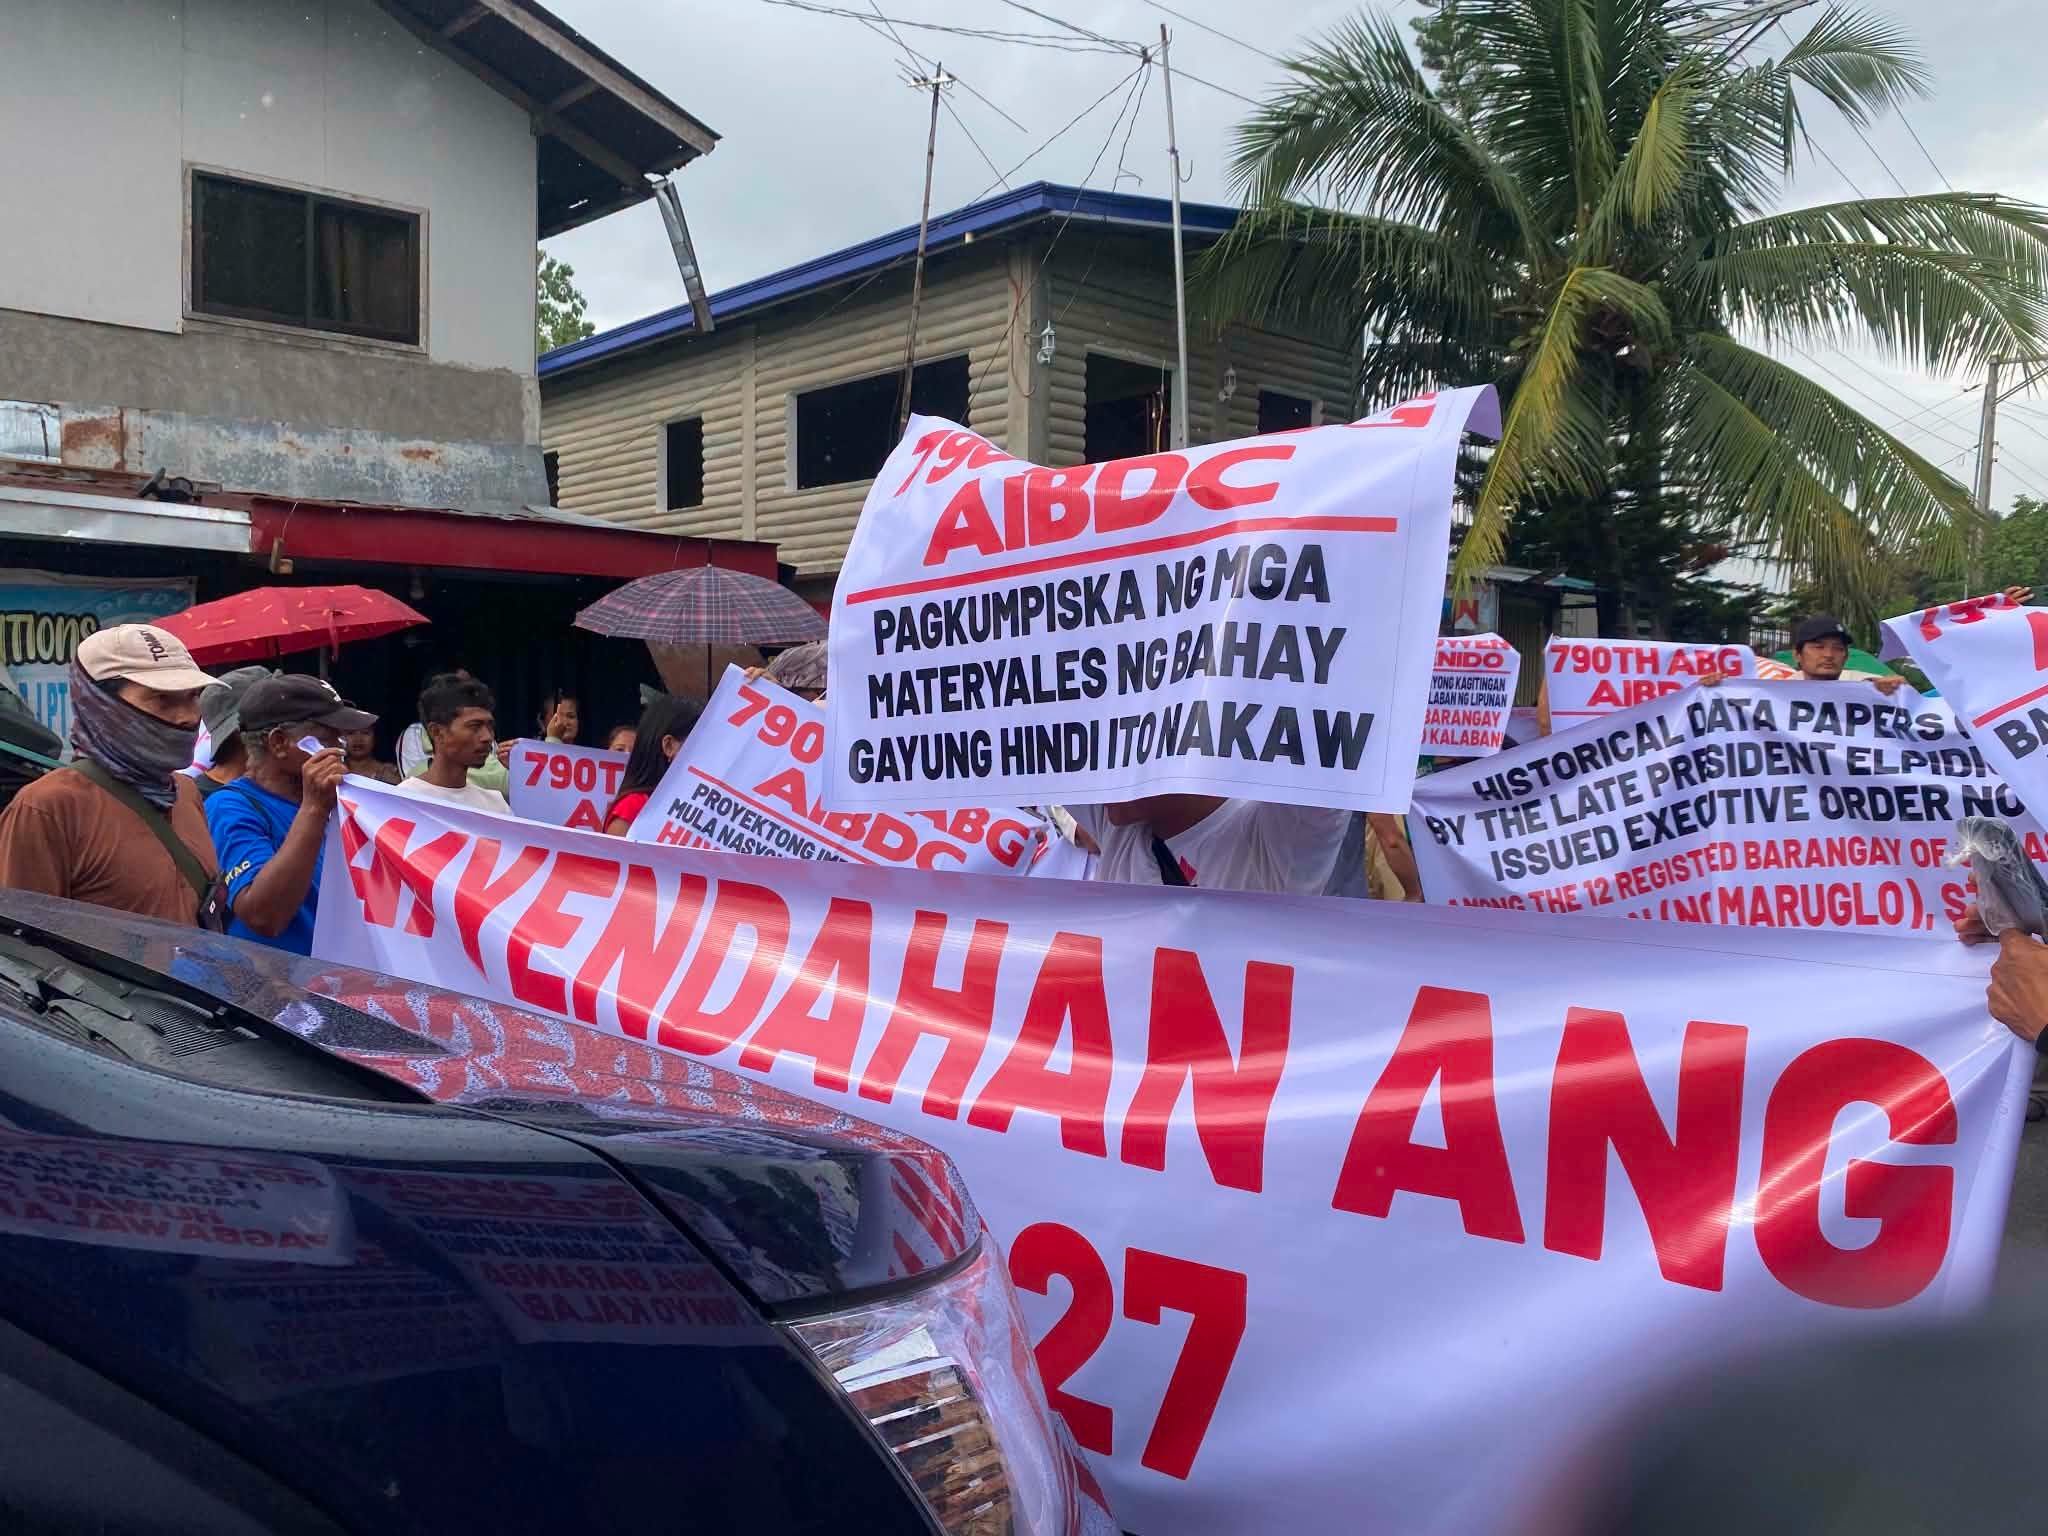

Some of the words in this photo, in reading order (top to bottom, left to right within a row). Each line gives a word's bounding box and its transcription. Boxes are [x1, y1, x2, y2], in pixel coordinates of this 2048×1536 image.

[922, 445, 1297, 567] AIBDC
[873, 569, 1146, 655] PAGKUMPISKA
[1156, 555, 1206, 617] NG
[1209, 543, 1331, 603] MGA
[867, 647, 1108, 719] MATERYALES
[1117, 638, 1168, 696] NG
[1170, 621, 1347, 685] BAHAY
[1434, 651, 1504, 669] NIDO
[1455, 676, 1506, 693] KAGITINGAN
[1551, 645, 1660, 674] 790TH
[1667, 648, 1743, 677] ABG
[727, 684, 825, 764] 790
[1458, 692, 1470, 707] NG
[1471, 692, 1507, 708] LIPUNAN
[525, 751, 625, 795] 790T
[848, 729, 993, 785] GAYUNG
[1000, 719, 1099, 777] HINDI
[1107, 712, 1157, 769] ITO
[1155, 700, 1375, 771] NAKAW
[1472, 715, 1685, 800] HISTORICAL
[1686, 698, 1777, 738] DATA
[1789, 700, 1945, 743] PAPERS
[666, 798, 718, 839] MULA
[692, 783, 817, 862] PROYEKTONG
[1425, 814, 1466, 846] BY
[1475, 799, 1548, 843] THE
[1550, 769, 1644, 827] LATE
[1491, 824, 1620, 882] ISSUED
[1819, 784, 1953, 822] ORDER
[1528, 884, 1583, 914] THE
[1584, 876, 1615, 907] 12
[1615, 841, 1737, 901] REGISTED
[1744, 836, 1903, 870] BARANGAY
[1910, 837, 1948, 868] OF
[1718, 878, 1935, 931] MARUGLO),
[1332, 984, 1960, 1312] ANG
[1008, 1221, 1249, 1482] 27
